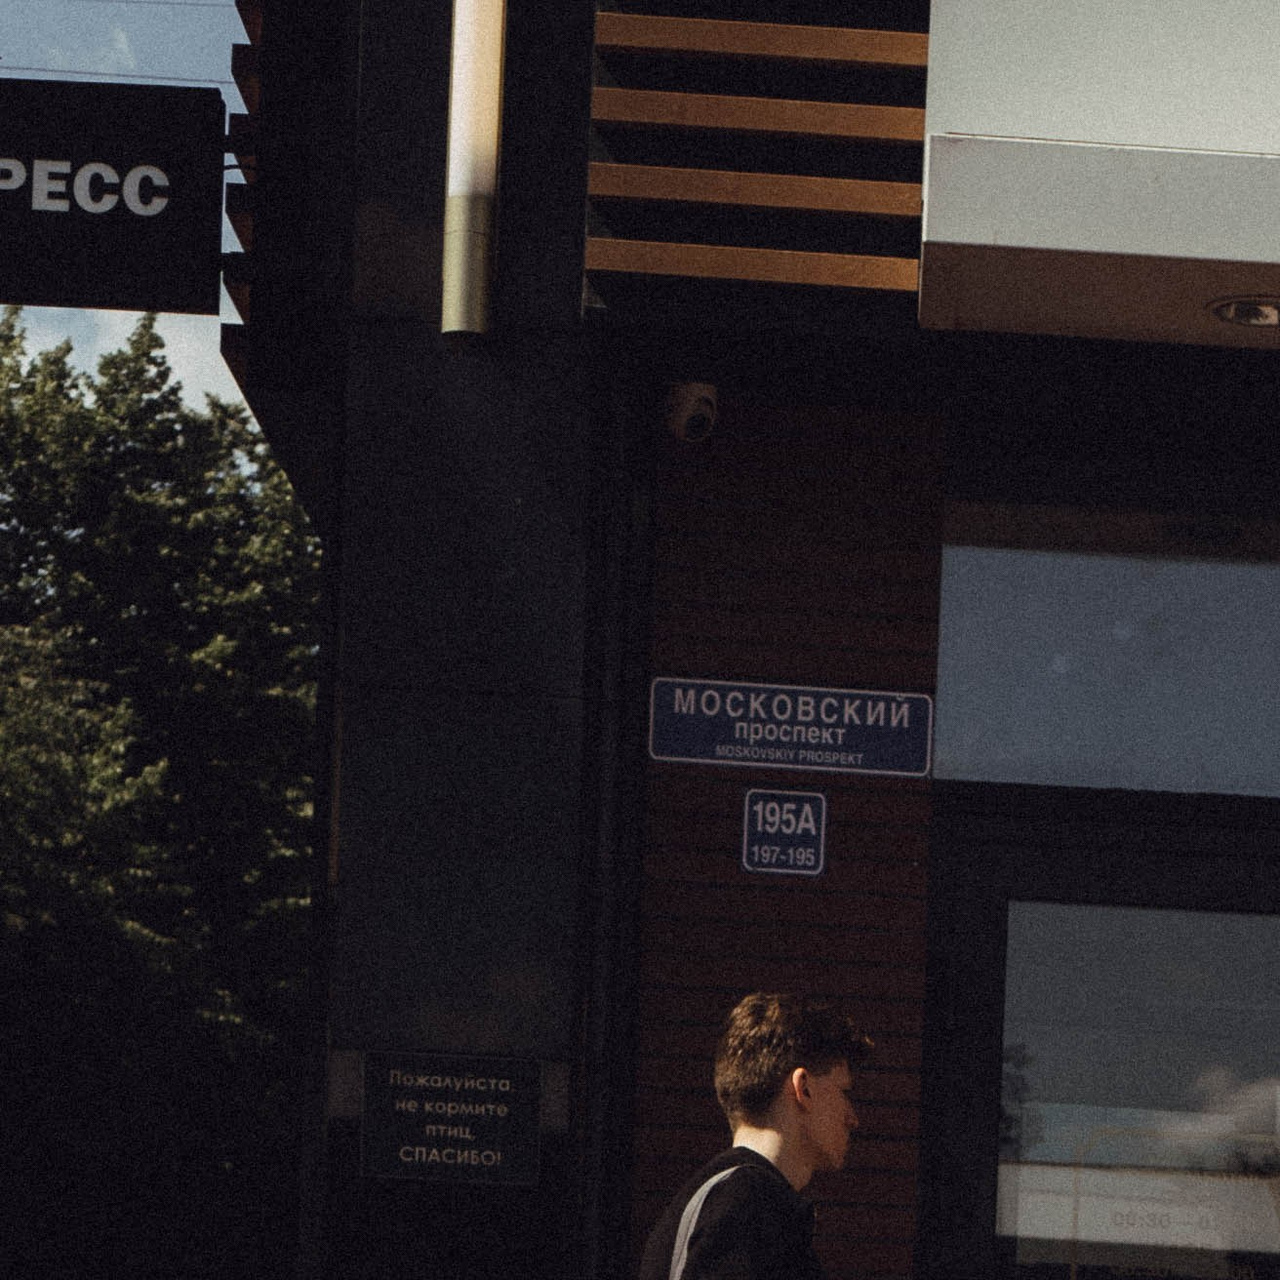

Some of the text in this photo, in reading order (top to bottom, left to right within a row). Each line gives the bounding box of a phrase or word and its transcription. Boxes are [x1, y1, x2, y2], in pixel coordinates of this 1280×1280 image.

[674, 687, 910, 729] МОСКОВСКИЙ
[734, 721, 846, 745] проспект
[715, 744, 864, 765] MOSKOVSKIY PROSPEKT
[753, 801, 817, 835] 195А
[751, 844, 816, 866] 197-195
[395, 1099, 509, 1117] не кормите
[399, 1146, 502, 1167] СПАСИБО!
